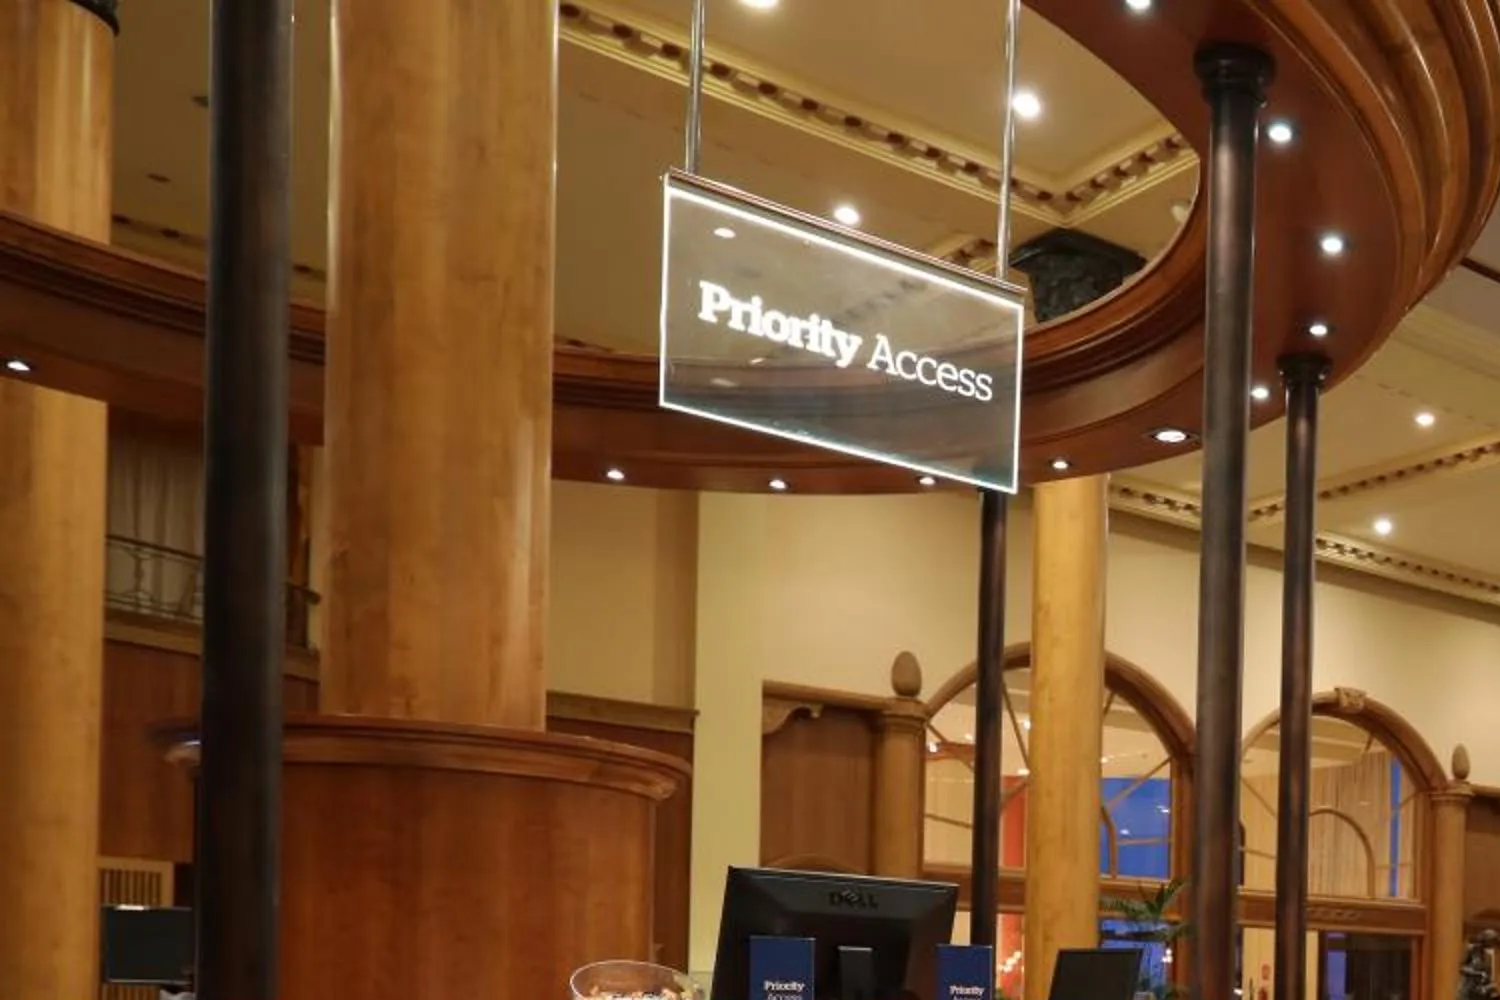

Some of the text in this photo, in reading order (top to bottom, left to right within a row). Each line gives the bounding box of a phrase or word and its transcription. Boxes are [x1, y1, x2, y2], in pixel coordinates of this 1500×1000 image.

[697, 280, 993, 401] Priority Access
[764, 980, 805, 992] Priority
[949, 985, 985, 996] Priority
